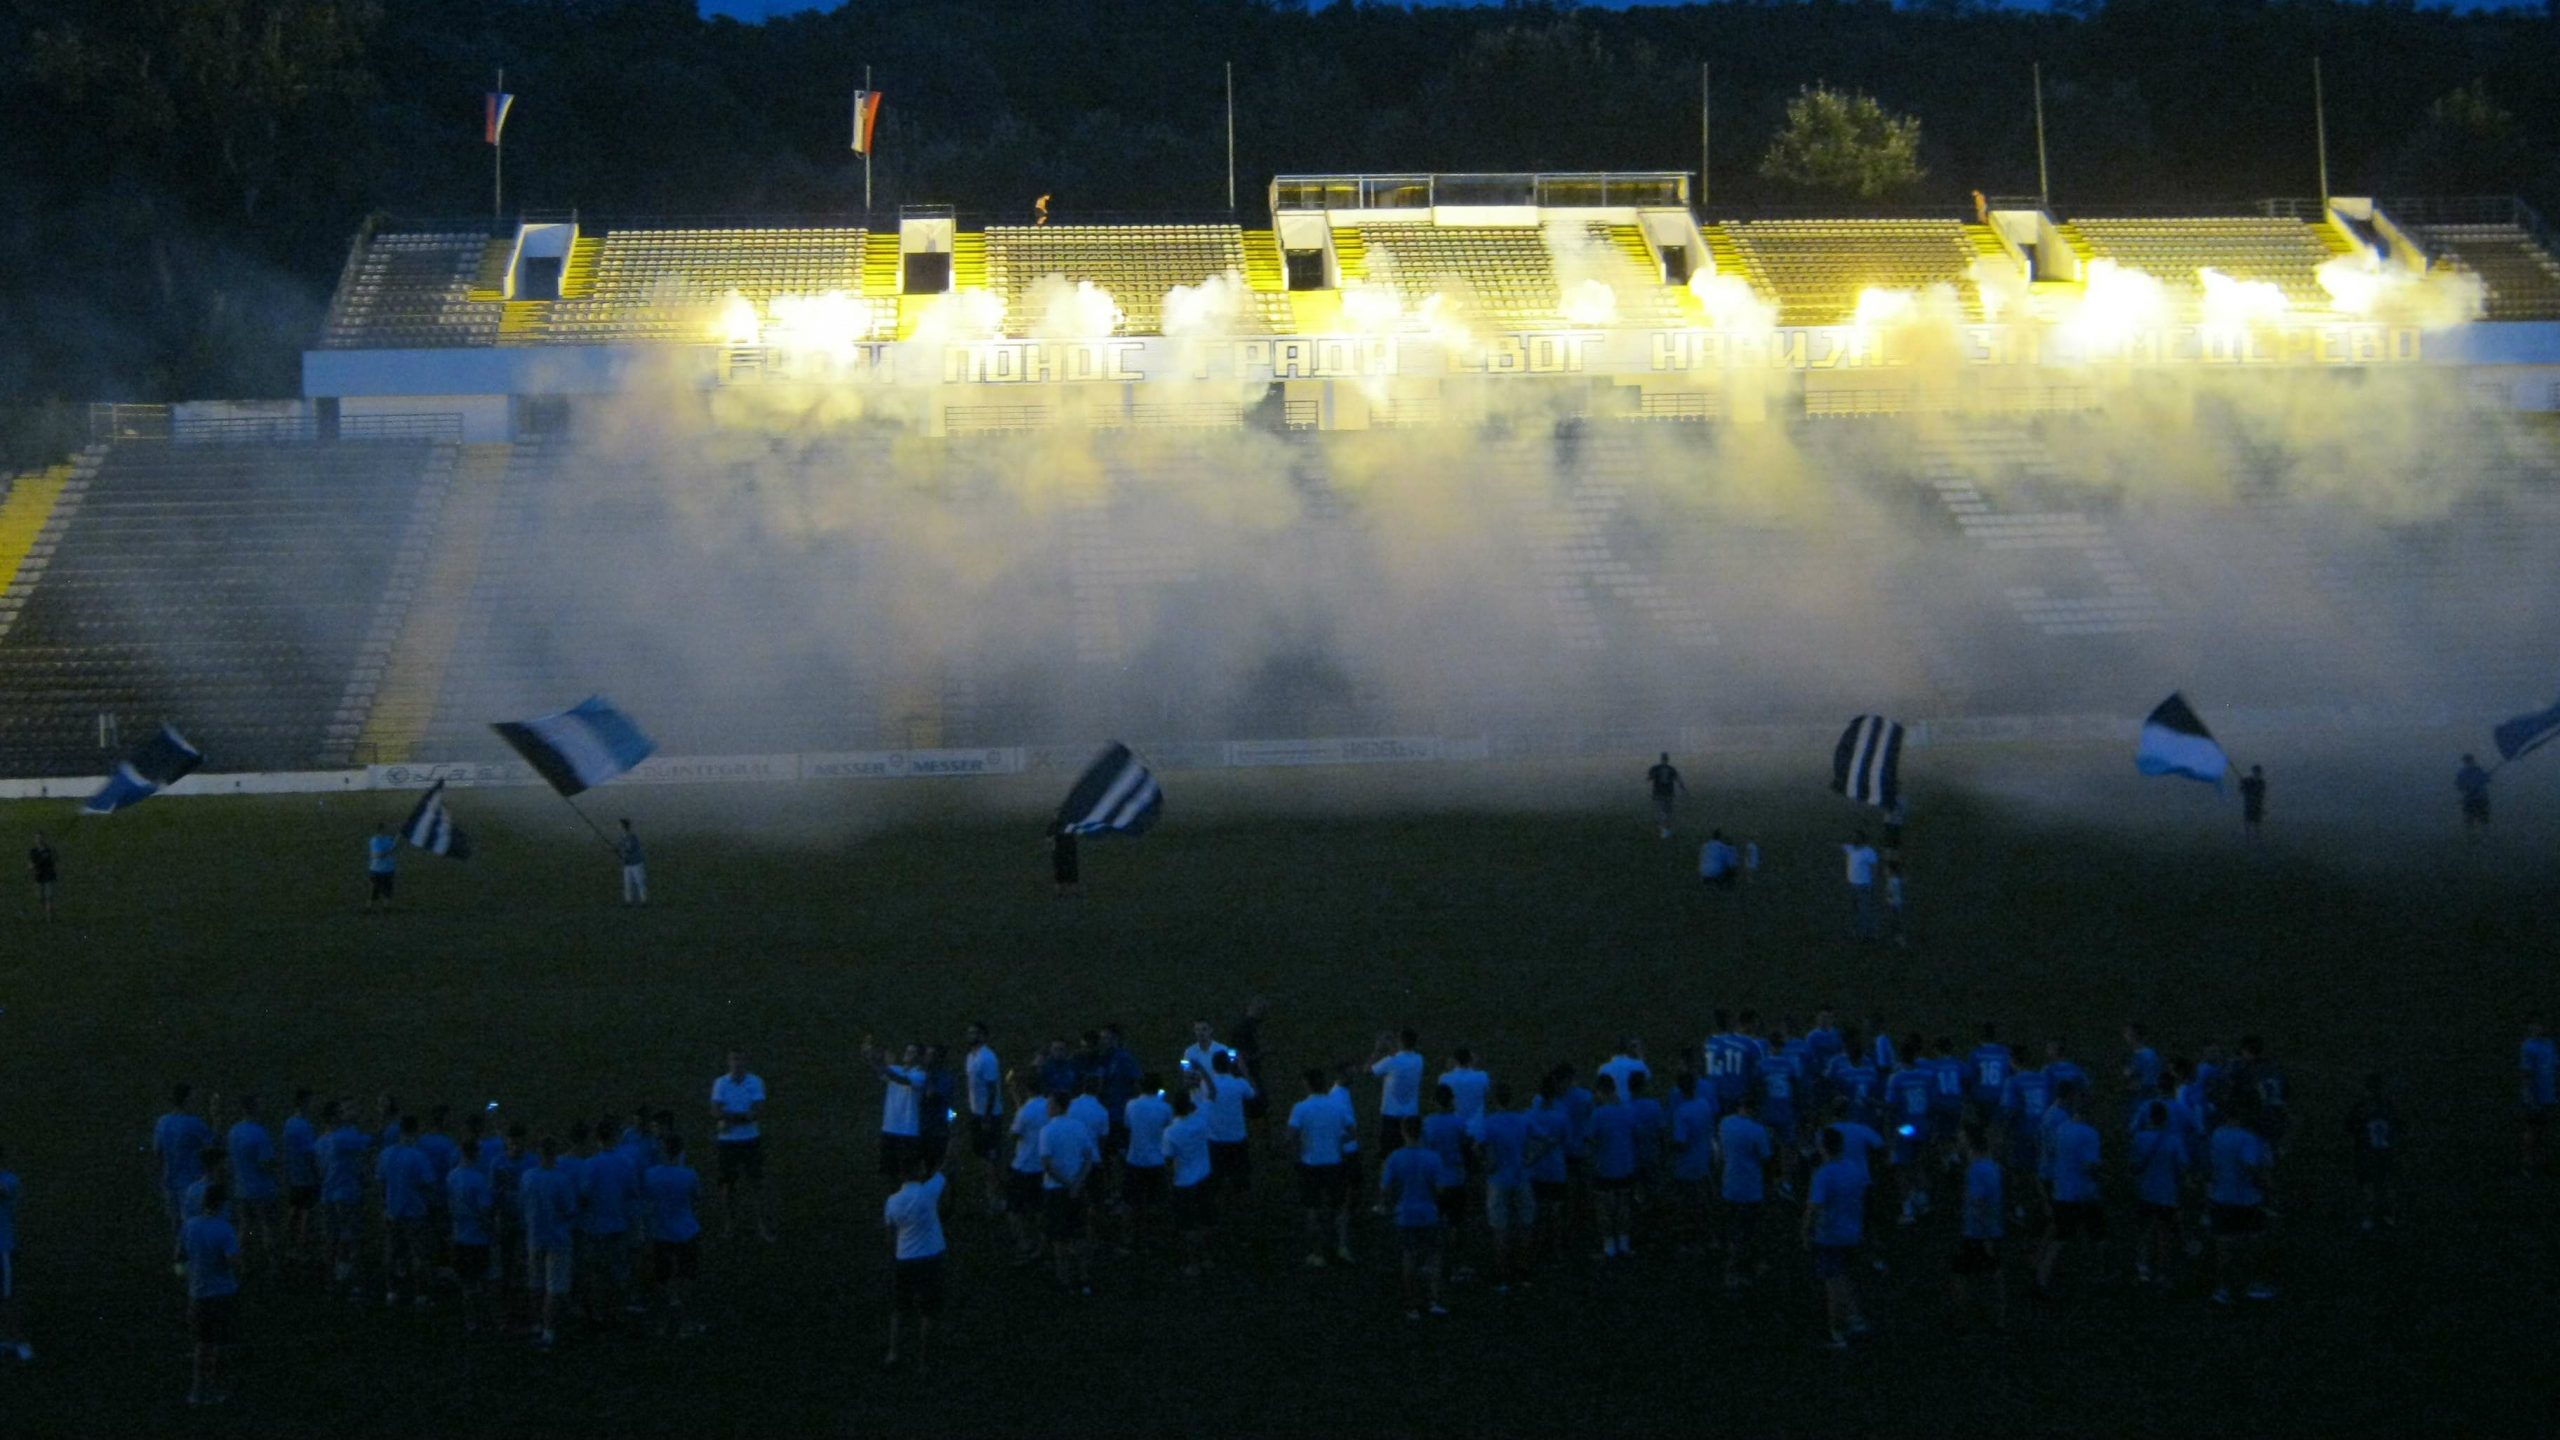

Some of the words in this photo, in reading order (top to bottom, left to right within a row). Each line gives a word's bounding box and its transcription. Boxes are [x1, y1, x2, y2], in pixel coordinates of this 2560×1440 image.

[943, 342, 1145, 383] ПОНОС
[1195, 338, 1399, 378] ГРАДА
[814, 763, 886, 776] MESSER
[914, 759, 984, 772] MESSER
[1978, 1060, 2003, 1087] 16
